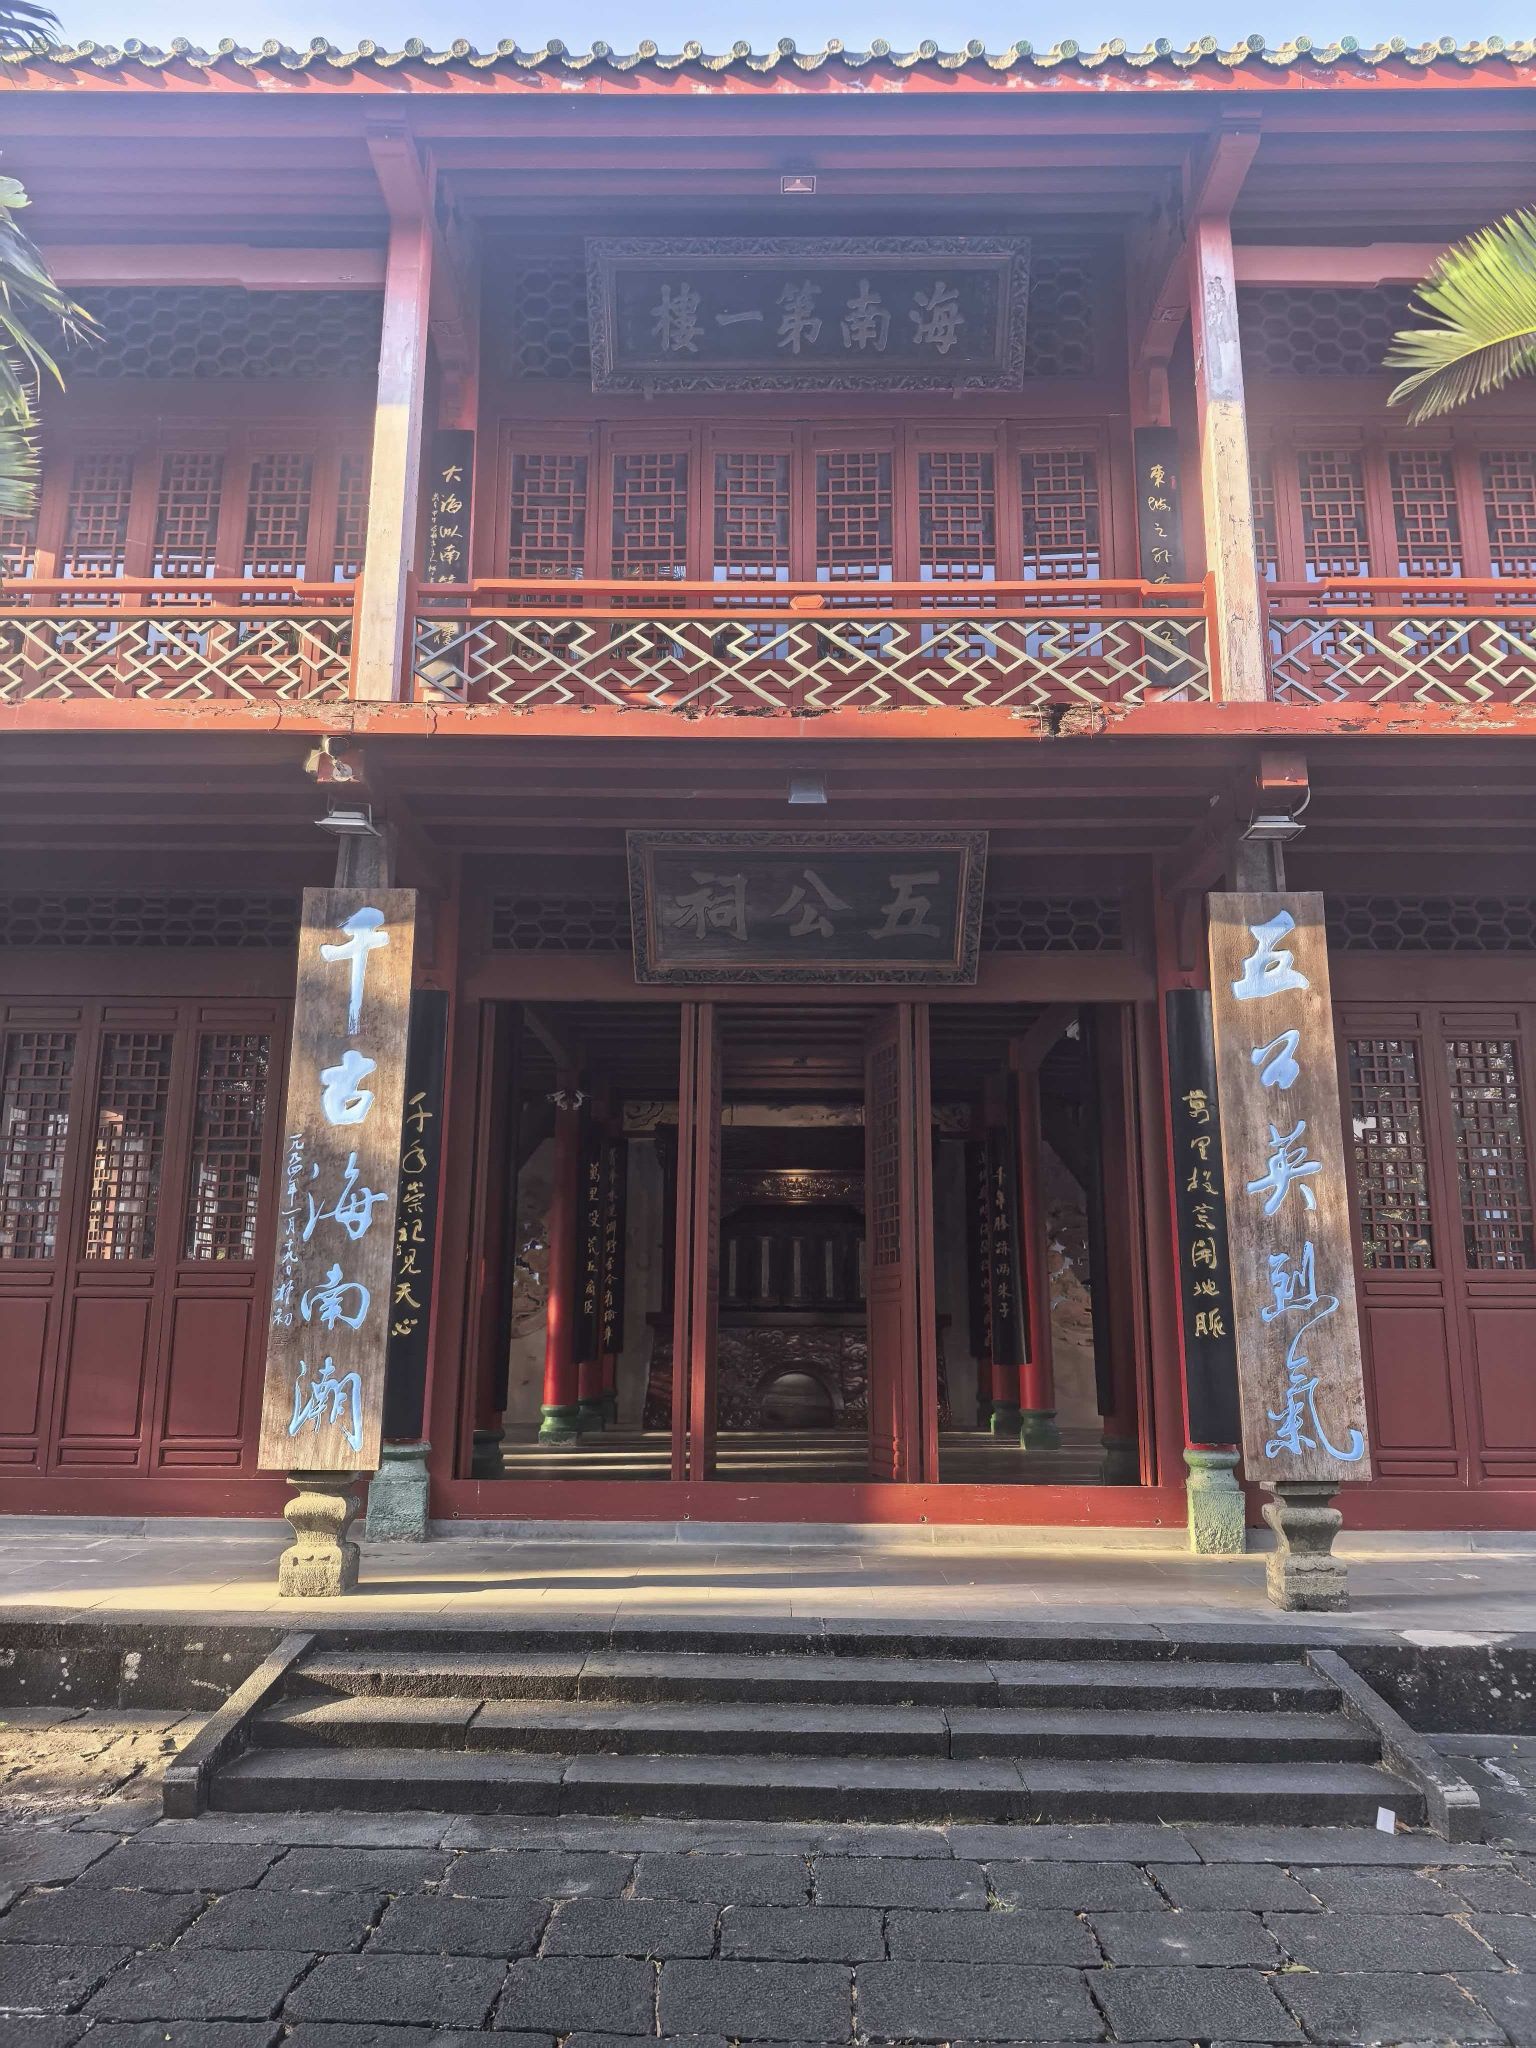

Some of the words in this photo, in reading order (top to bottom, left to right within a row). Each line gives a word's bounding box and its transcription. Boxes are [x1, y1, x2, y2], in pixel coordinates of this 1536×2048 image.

[650, 278, 965, 355] 海南第一樓
[673, 869, 941, 941] 五公祠
[288, 906, 391, 1454] 千古海南潮
